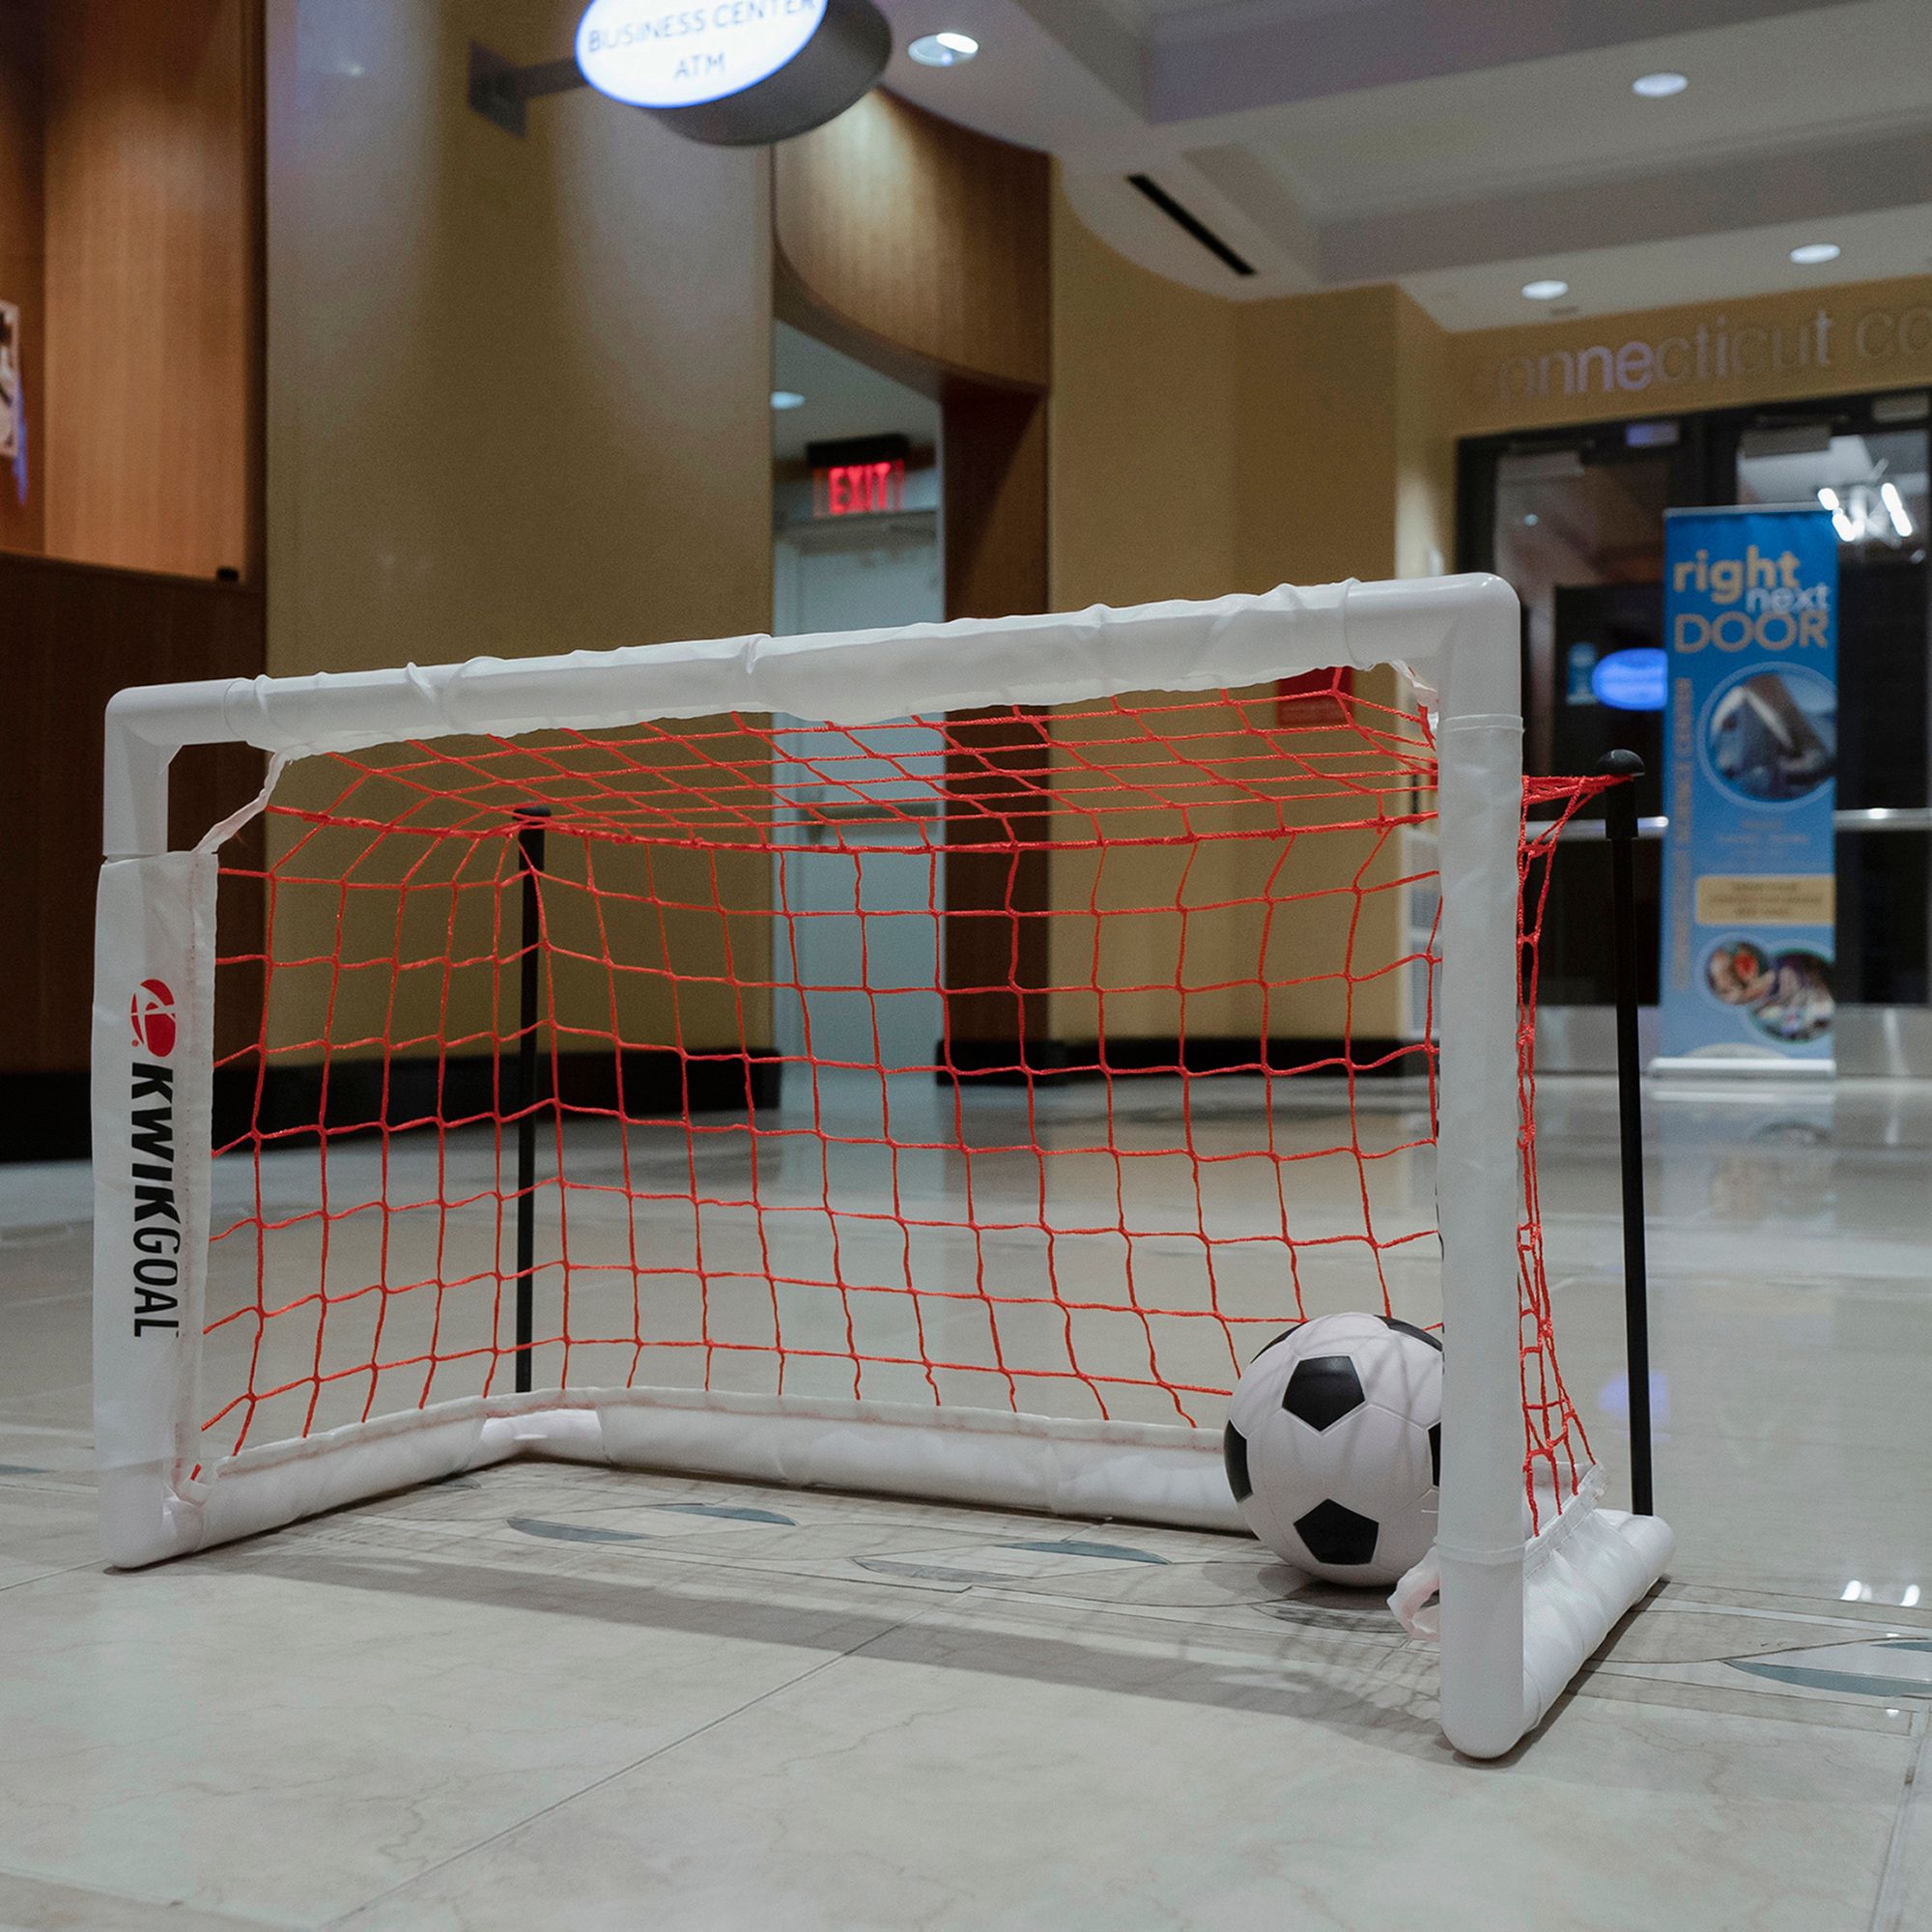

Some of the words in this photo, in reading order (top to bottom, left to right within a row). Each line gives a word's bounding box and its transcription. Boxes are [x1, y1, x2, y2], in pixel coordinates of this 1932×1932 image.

[588, 10, 705, 51] BUSINESS
[675, 53, 724, 79] ATM
[828, 462, 891, 515] EXIT
[1673, 544, 1801, 605] right
[1746, 582, 1829, 615] next
[1674, 610, 1829, 653] DOOR
